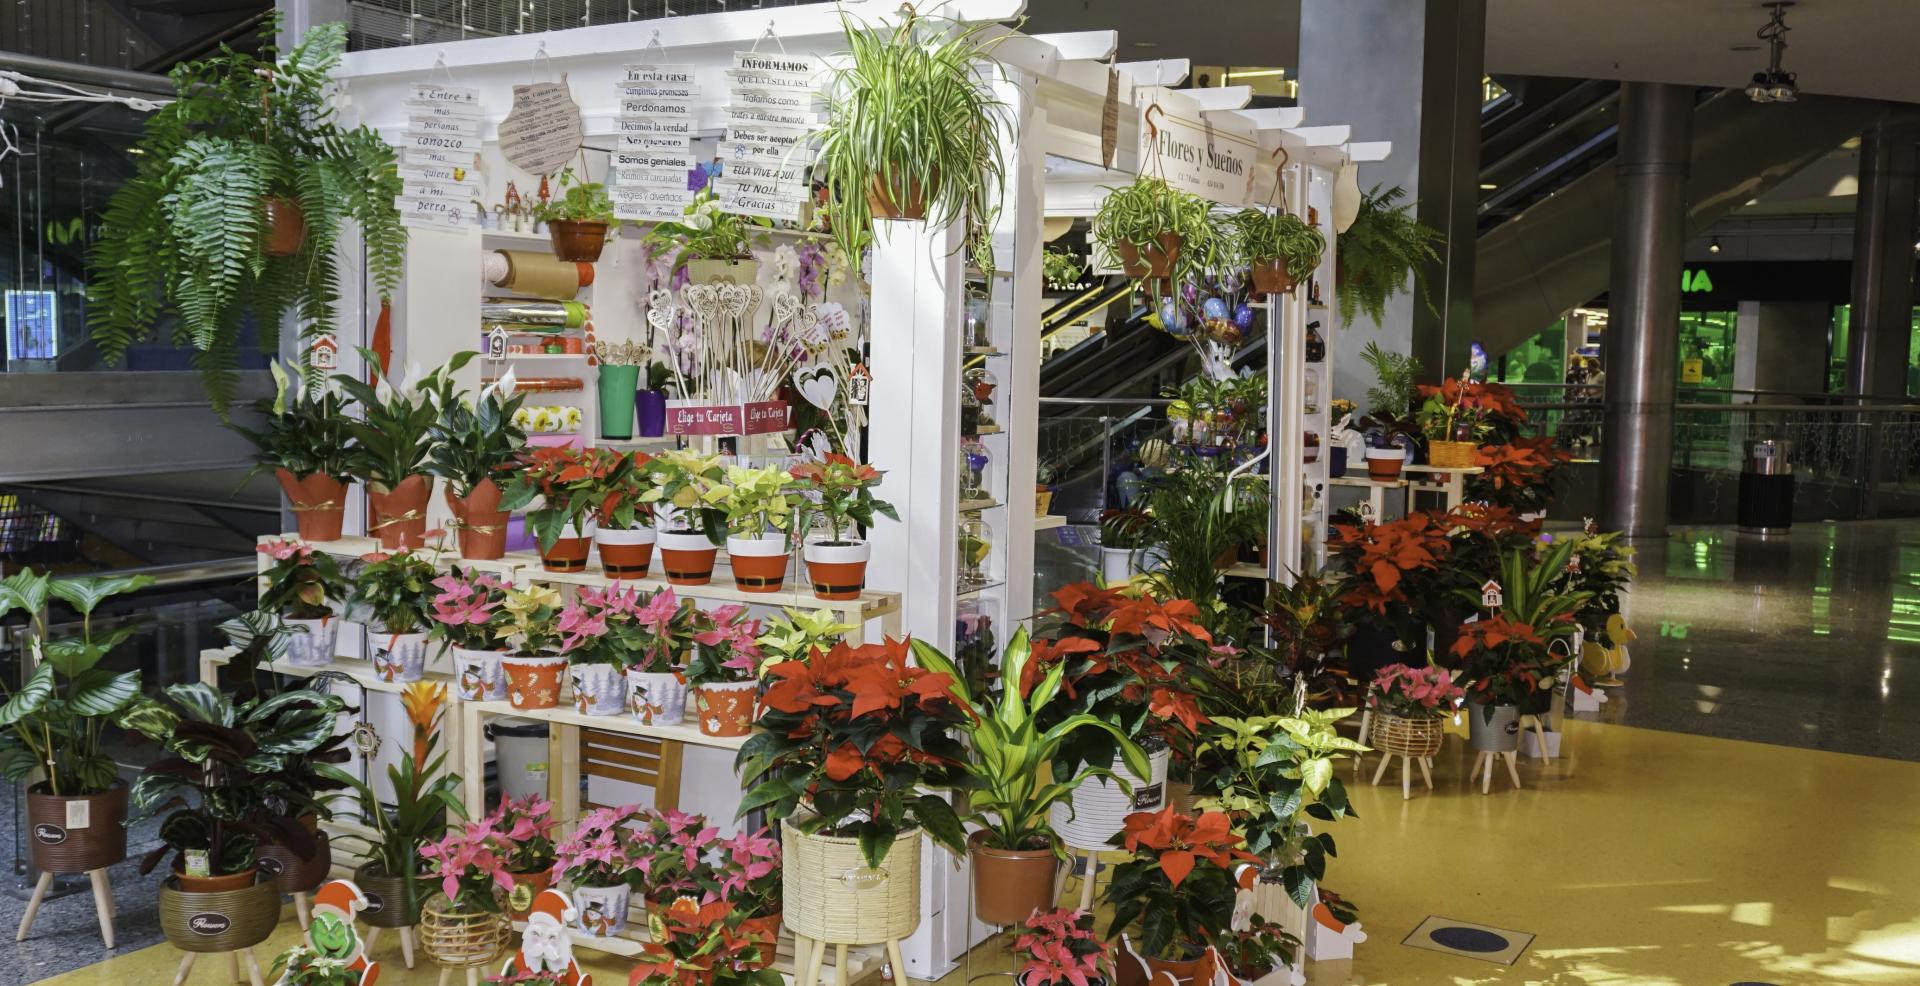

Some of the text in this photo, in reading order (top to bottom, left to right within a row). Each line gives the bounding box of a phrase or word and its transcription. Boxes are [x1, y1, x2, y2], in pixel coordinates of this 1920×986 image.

[742, 58, 808, 72] INFORMAMOS
[628, 70, 687, 82] En esta casa
[737, 75, 753, 84] QUE
[767, 78, 785, 87] ESTA
[787, 79, 808, 87] CASA
[429, 89, 460, 100] Entre
[659, 88, 689, 98] promesas
[743, 93, 776, 104] Tratamos
[626, 102, 686, 113] Perdonamos
[621, 120, 688, 132] Decimos la verdad
[734, 130, 755, 140] Debes
[769, 136, 798, 145] aceptad
[752, 146, 779, 155] por ella
[1160, 129, 1243, 177] Flores y Sueños
[618, 155, 686, 167] Somos geniales
[733, 165, 751, 175] ELLA
[753, 168, 771, 177] VIVE
[737, 183, 751, 192] TU
[417, 200, 446, 212] perro
[737, 196, 775, 210] Gracias
[677, 409, 733, 426] Elige tu Tarjeta
[750, 407, 784, 423] Elige tu Tarjeta
